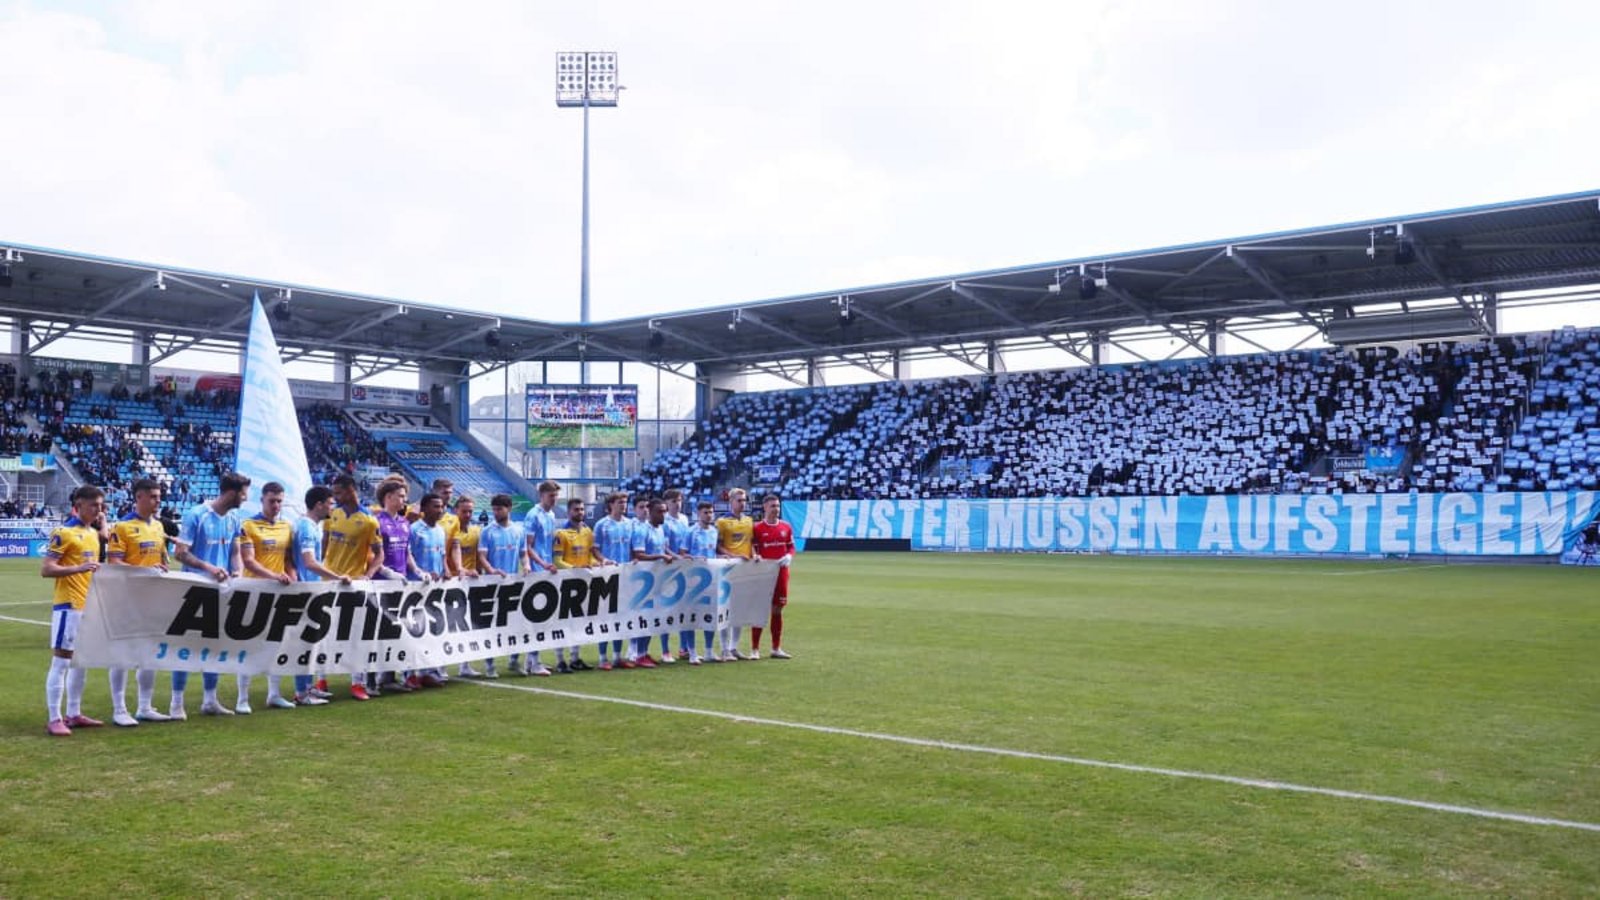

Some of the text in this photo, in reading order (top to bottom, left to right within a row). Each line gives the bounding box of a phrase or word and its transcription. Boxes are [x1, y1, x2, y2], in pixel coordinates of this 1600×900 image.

[803, 492, 1594, 555] MEISTER MÜSSEN AUFSTEIGEN!
[8, 545, 28, 555] Shop
[166, 573, 619, 642] AUFSTIEGSREFORM
[277, 650, 343, 667] oder
[368, 649, 407, 664] nie
[443, 630, 564, 656] Gemeinsam
